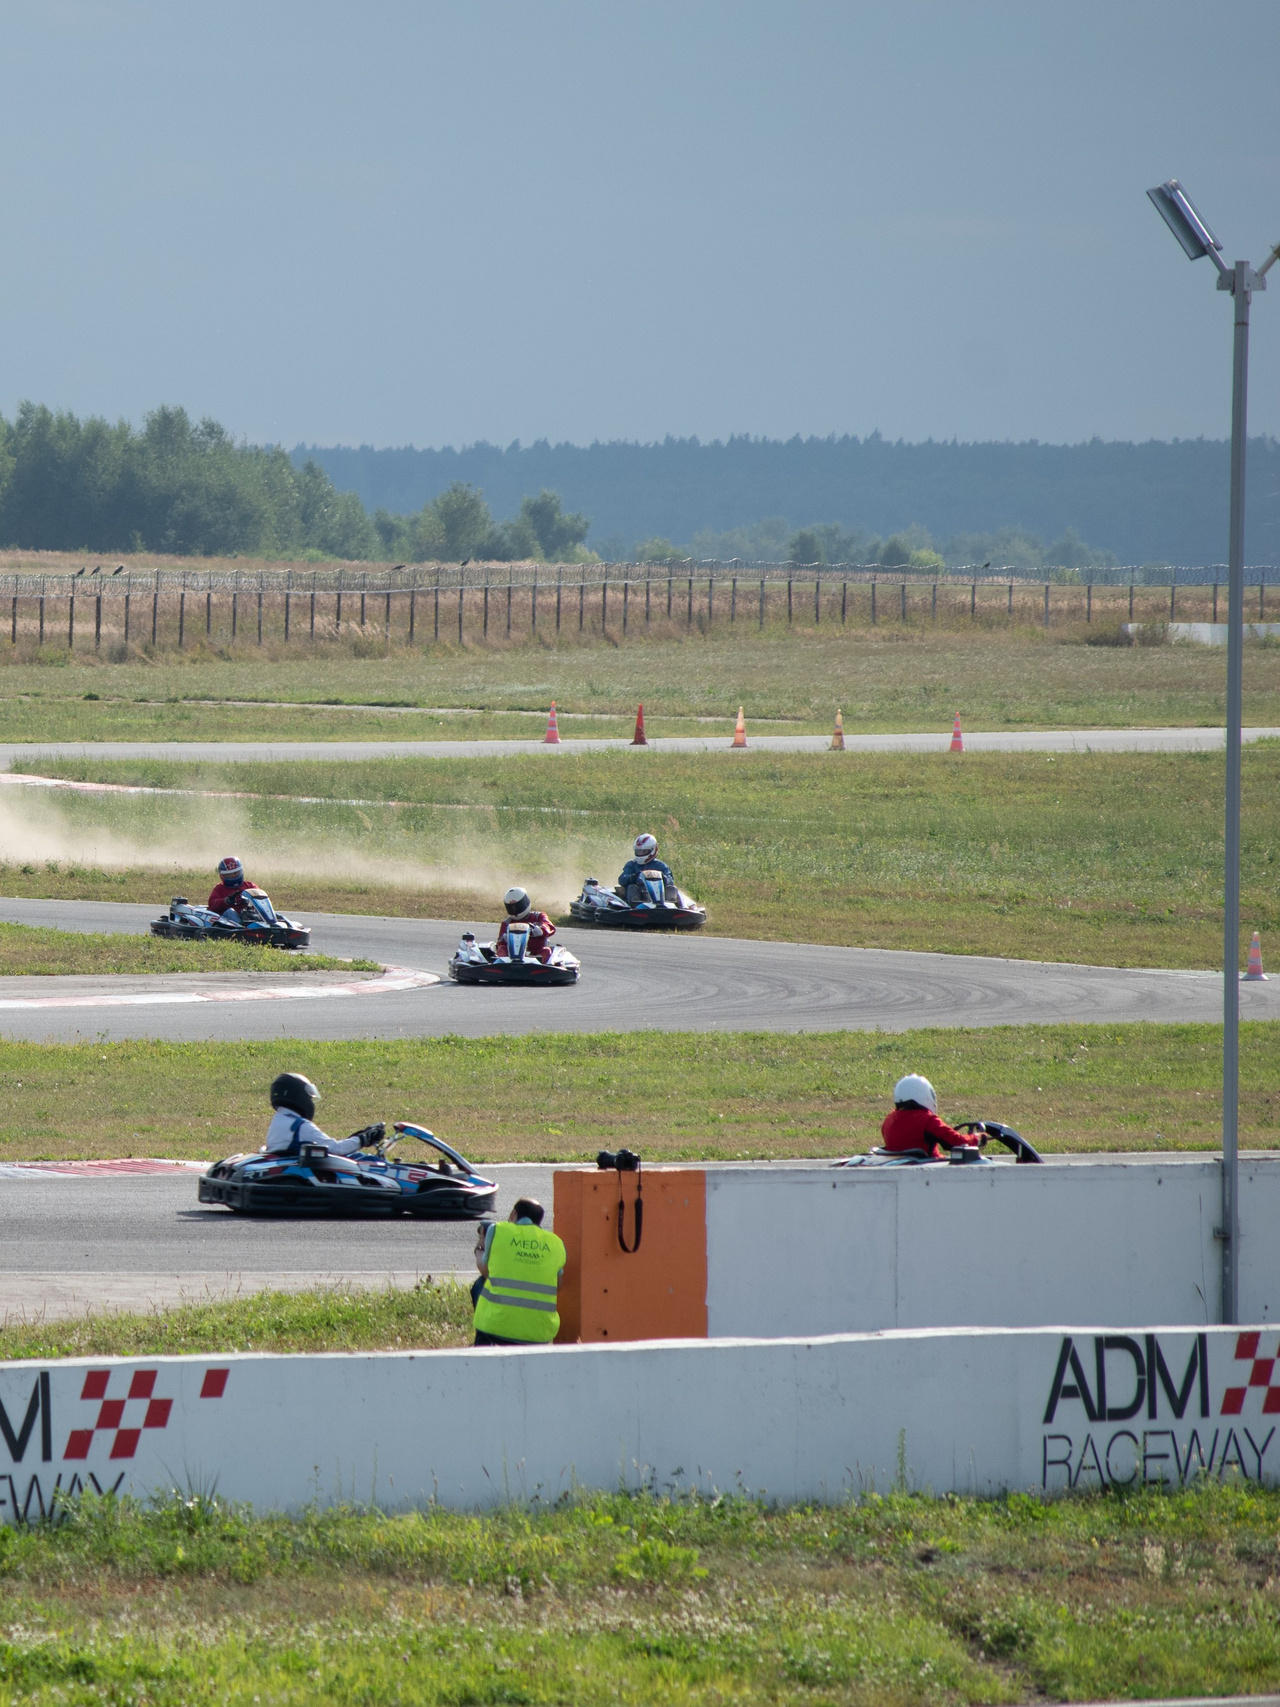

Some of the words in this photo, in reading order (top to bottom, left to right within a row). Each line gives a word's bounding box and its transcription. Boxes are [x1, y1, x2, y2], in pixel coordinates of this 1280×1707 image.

[510, 1238, 551, 1253] MEDIA
[1042, 1333, 1210, 1424] ADM
[1042, 1427, 1276, 1491] RACEWAY
